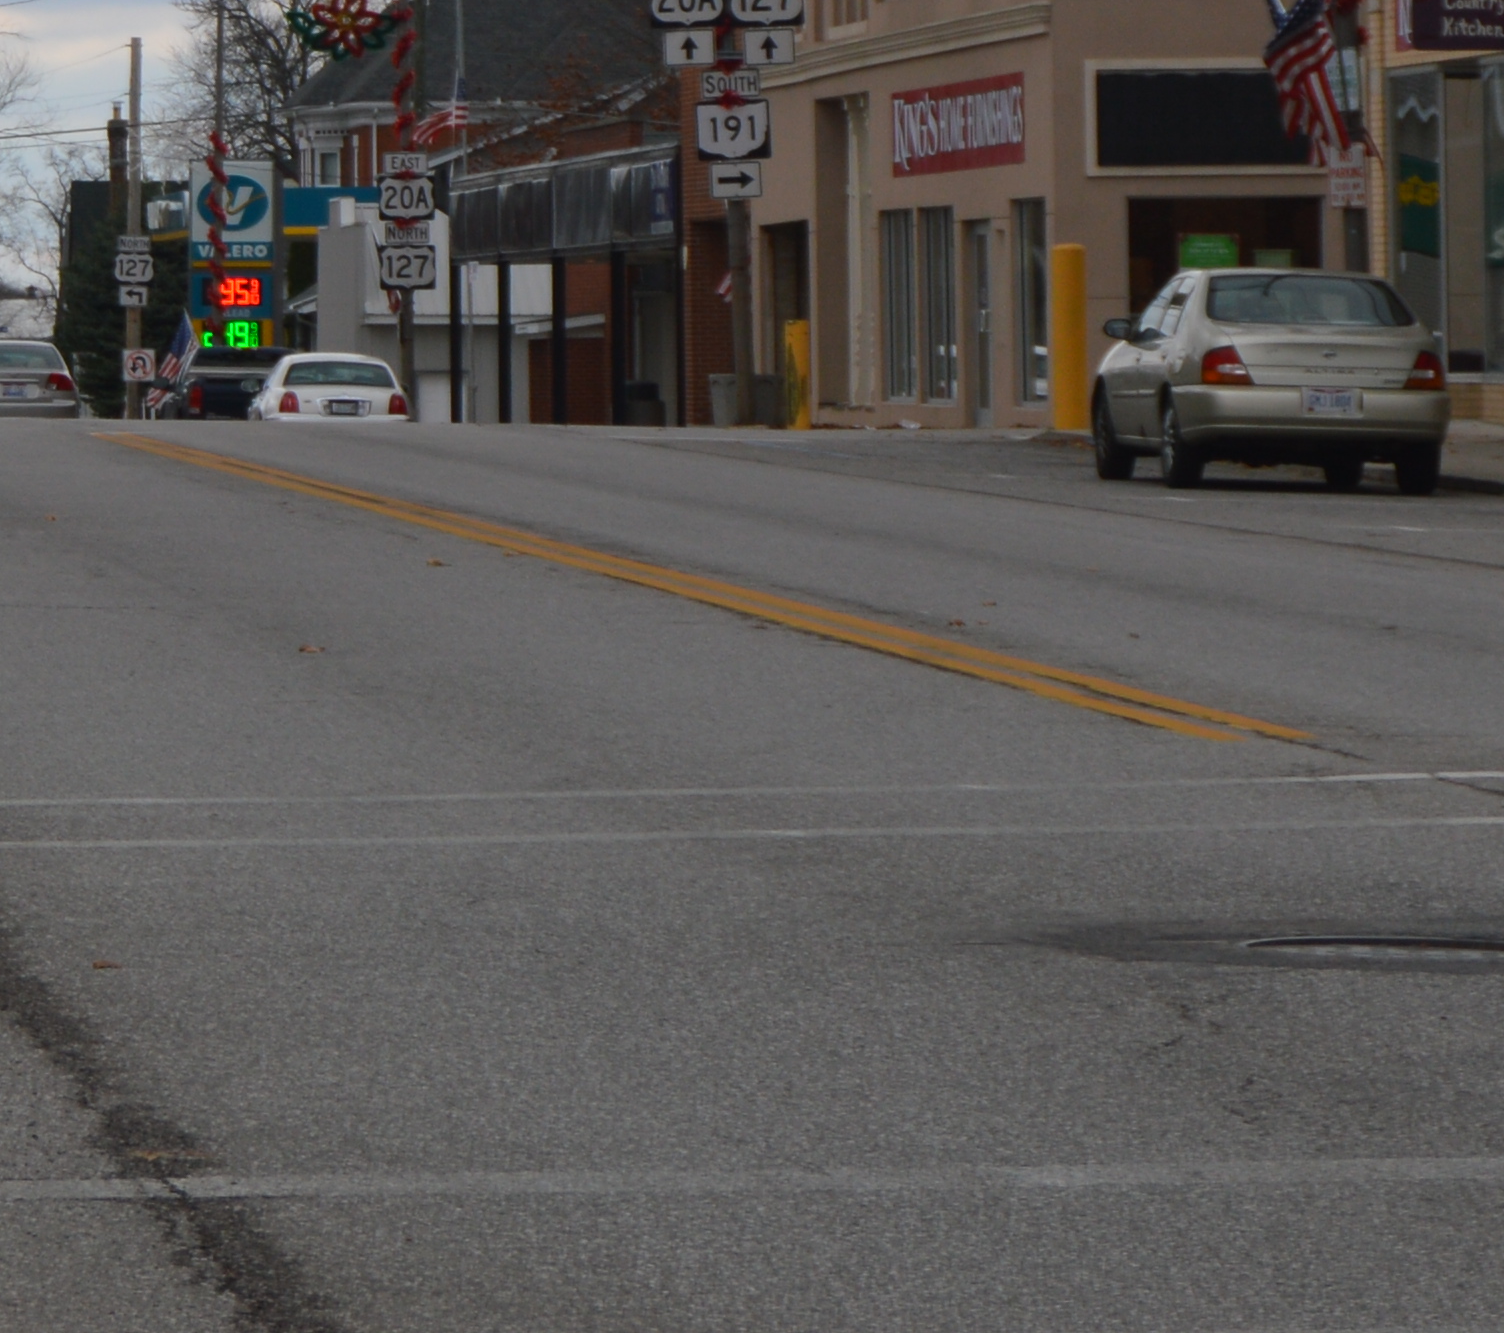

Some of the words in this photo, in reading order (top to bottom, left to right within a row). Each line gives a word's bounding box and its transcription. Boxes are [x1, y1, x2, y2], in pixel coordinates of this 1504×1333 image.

[704, 76, 757, 94] SOUTH
[710, 115, 756, 142] 191
[893, 92, 938, 171] KING'S
[939, 96, 966, 152] HOME
[967, 85, 1023, 149] FURNISHINGS
[392, 156, 421, 170] EAST
[384, 185, 429, 210] 20A
[387, 226, 428, 240] NORTH
[120, 237, 151, 249] NORTH
[197, 243, 268, 258] VERO
[118, 259, 151, 277] 127
[386, 254, 429, 279] 127
